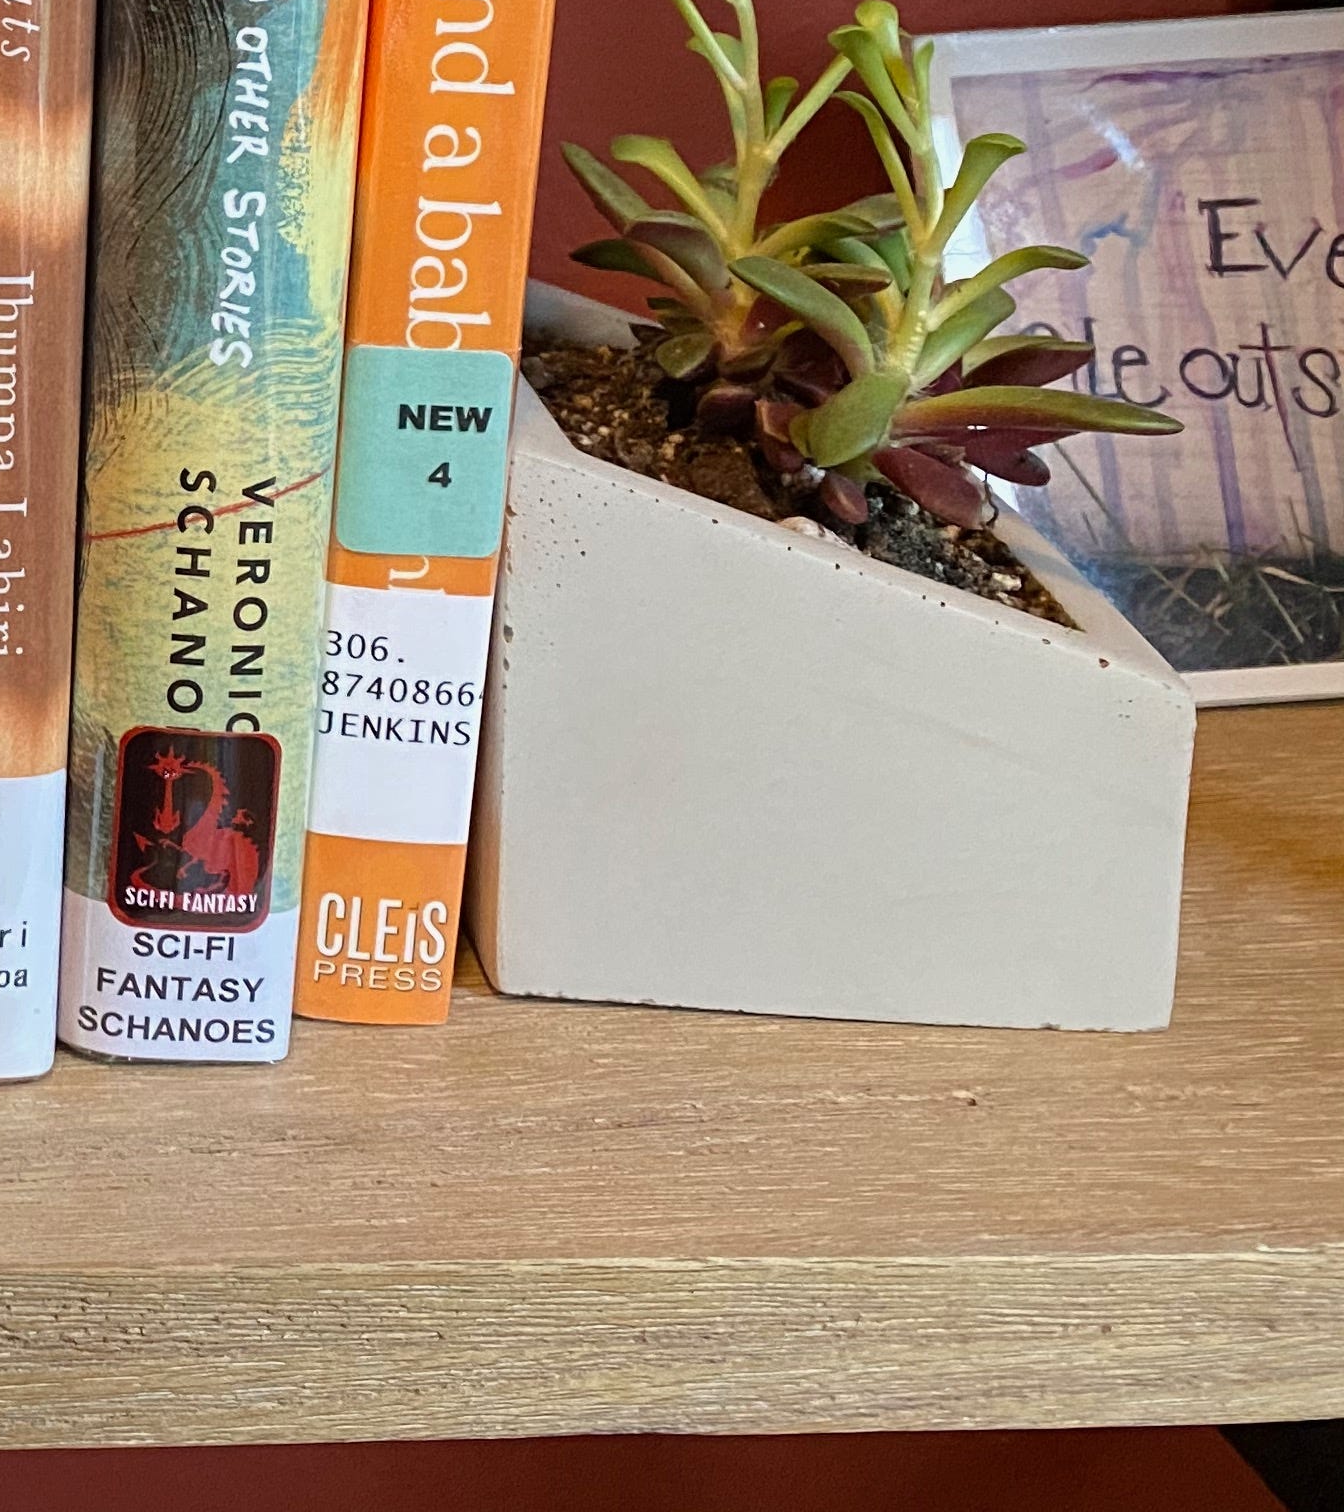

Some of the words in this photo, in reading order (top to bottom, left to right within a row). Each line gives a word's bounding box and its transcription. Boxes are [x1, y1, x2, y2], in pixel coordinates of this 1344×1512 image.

[226, 24, 274, 166] OTHER
[421, 123, 483, 173] a
[208, 187, 267, 370] STORIES
[397, 403, 494, 434] NEW
[427, 461, 453, 489] 4
[165, 466, 217, 732] SCHANO
[324, 629, 405, 664] 306.
[320, 670, 484, 708] 8740866
[317, 709, 472, 747] JENKINS
[181, 891, 260, 914] FANTASY
[131, 930, 236, 962] SCI-FI
[96, 966, 265, 1003] FANTASY
[312, 959, 442, 992] PRESS
[77, 1004, 276, 1045] SCHANOES
